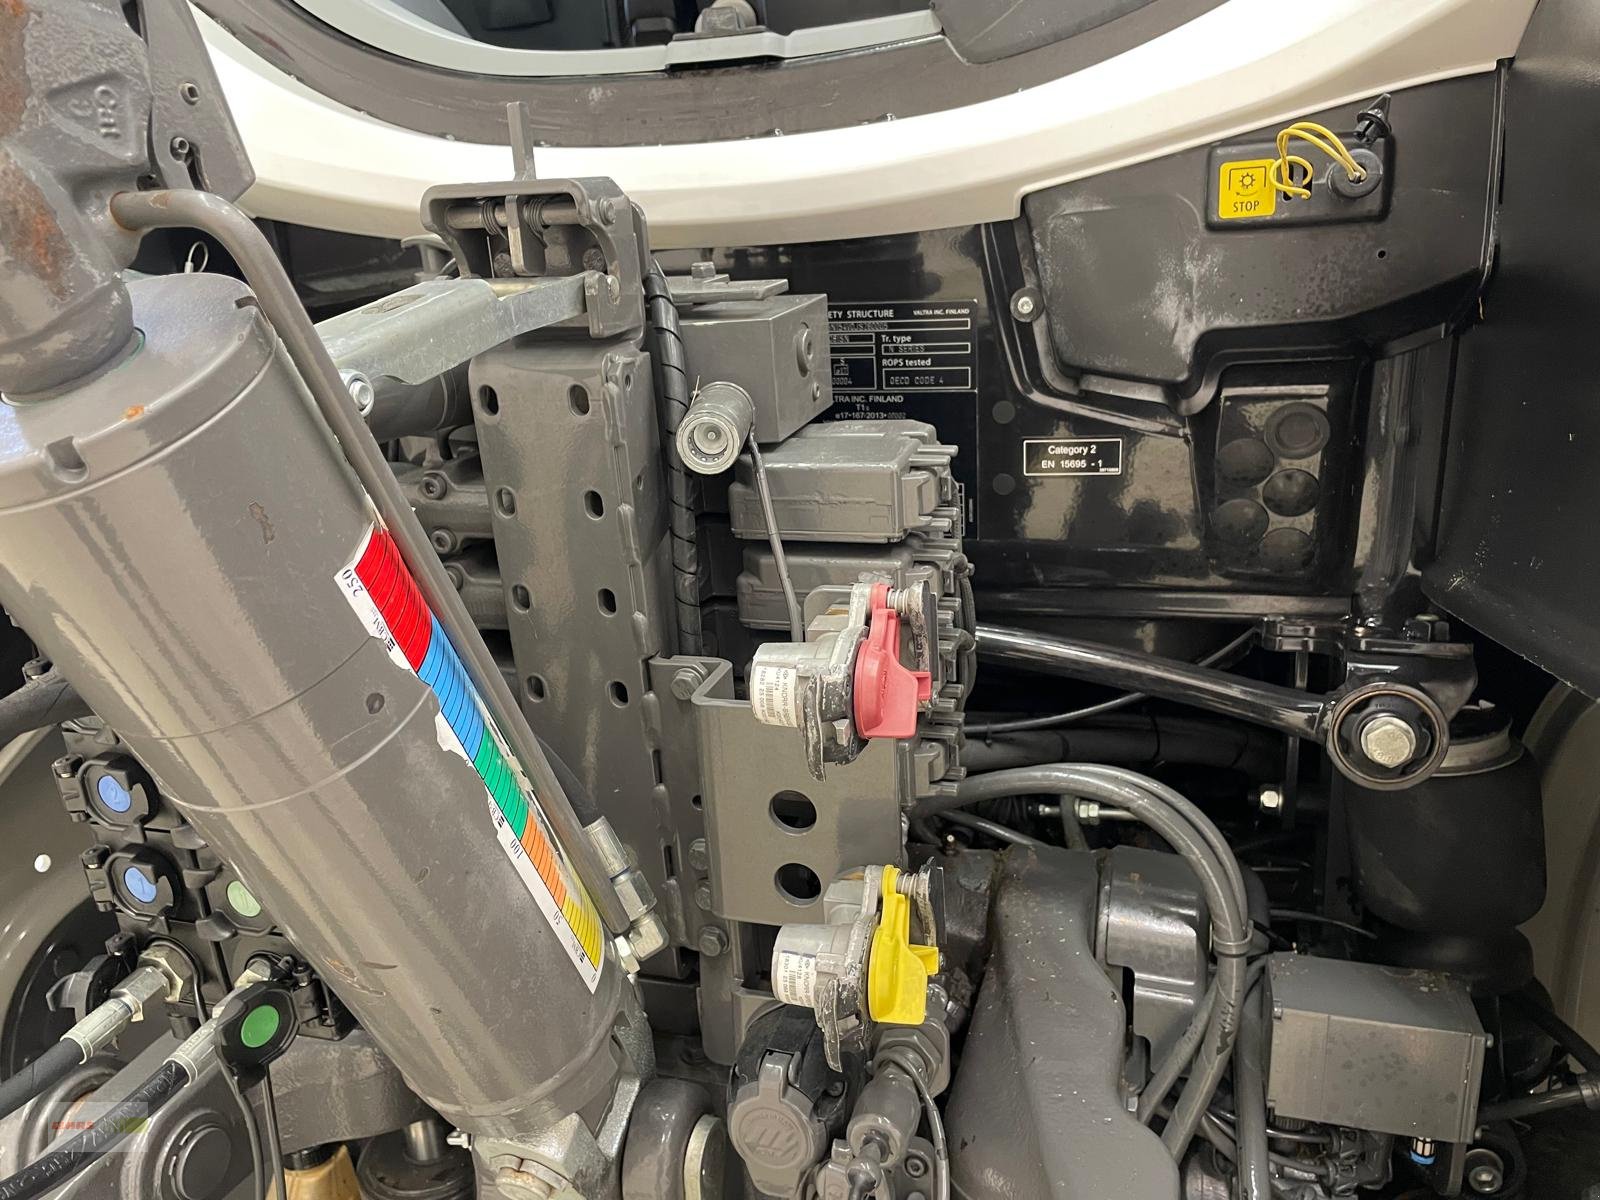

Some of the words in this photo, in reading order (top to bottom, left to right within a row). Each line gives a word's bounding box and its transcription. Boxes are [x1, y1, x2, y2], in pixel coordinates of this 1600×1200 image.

[1233, 200, 1260, 213] STOP
[847, 309, 895, 319] STRUCTURE
[945, 307, 970, 315] FINLAND
[881, 334, 891, 343] Tr.
[892, 334, 912, 344] type
[882, 358, 904, 367] ROPS
[905, 357, 932, 367] tested
[889, 376, 910, 385] OECD
[914, 376, 935, 385] CODE
[868, 394, 904, 403] FINLAND
[1048, 445, 1088, 456] Category
[1090, 445, 1097, 454] 2
[1041, 460, 1055, 469] EN
[1060, 460, 1087, 469] 15695
[342, 569, 363, 597] 250
[511, 839, 523, 859] 100
